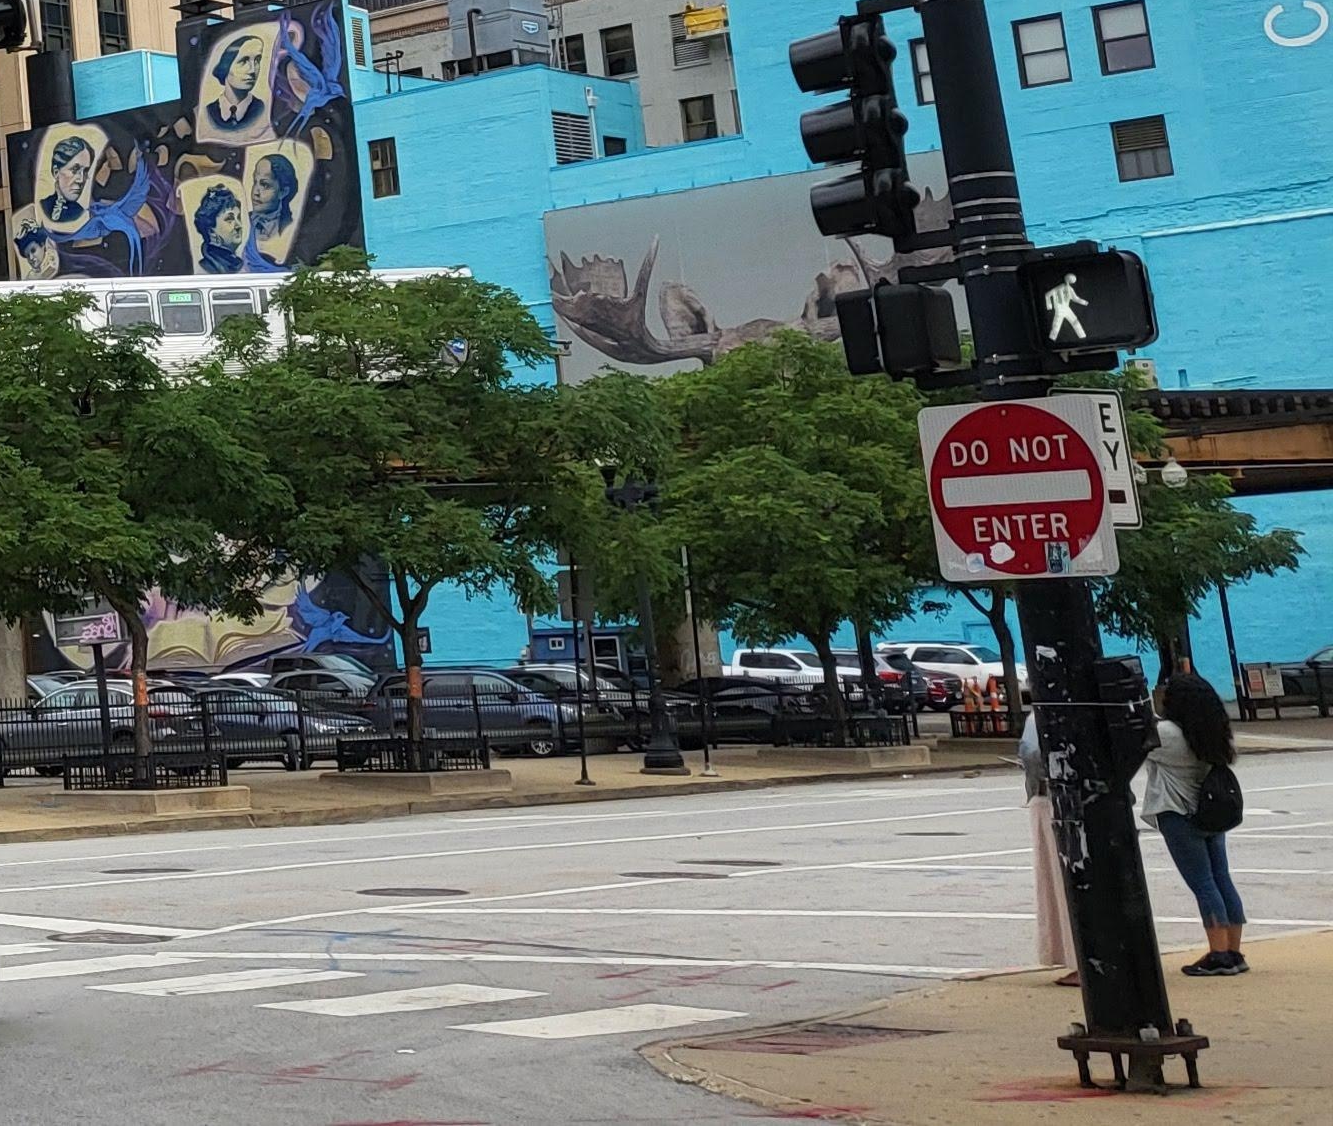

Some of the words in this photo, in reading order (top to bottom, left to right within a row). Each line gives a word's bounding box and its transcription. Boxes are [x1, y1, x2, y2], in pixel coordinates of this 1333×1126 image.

[949, 439, 989, 467] DO
[1009, 434, 1069, 464] NOT
[972, 512, 1070, 543] ENTER
